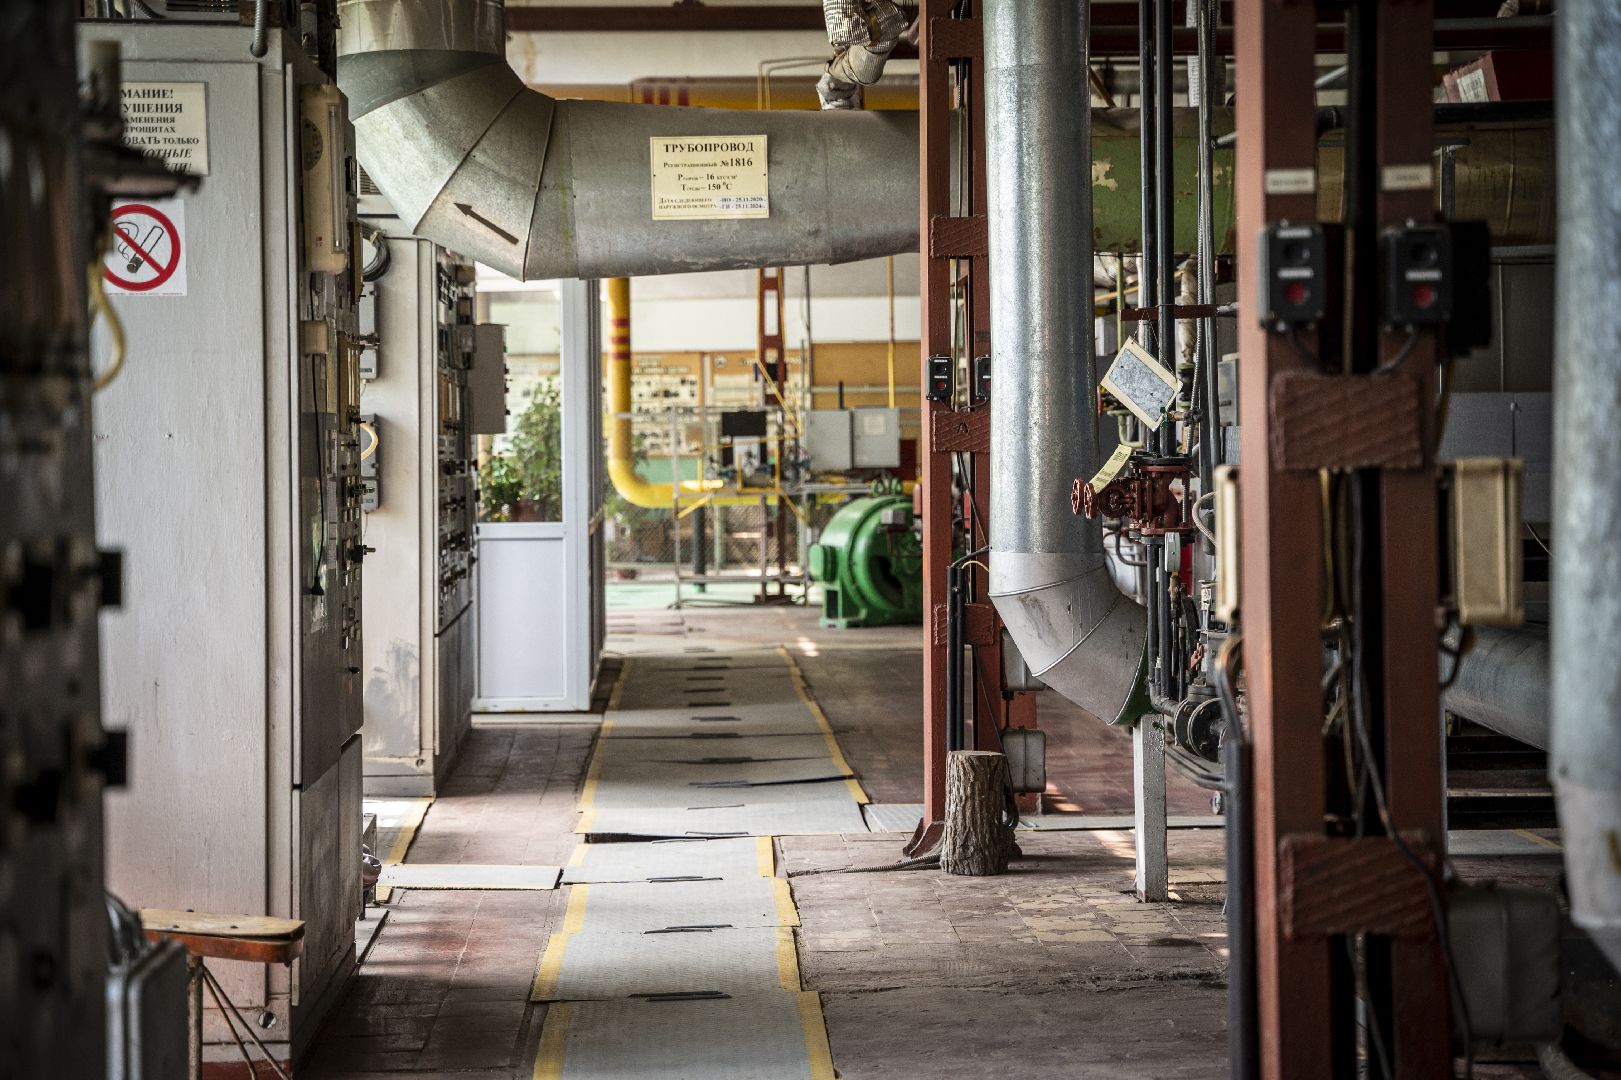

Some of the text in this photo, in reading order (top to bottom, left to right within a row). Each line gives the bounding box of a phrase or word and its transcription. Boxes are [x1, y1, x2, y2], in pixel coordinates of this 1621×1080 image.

[120, 88, 174, 99] МАНИЕ!
[120, 103, 184, 113] УШЕНИЯ
[121, 116, 176, 124] АМЕНЕНИЯ
[123, 126, 176, 134] ТРОЩИТАХ
[120, 136, 161, 145] ОВАТЬ
[663, 142, 754, 153] ТРУБОПРОВОД
[720, 157, 753, 168] №1816
[706, 173, 715, 181] 16
[708, 183, 721, 191] 150
